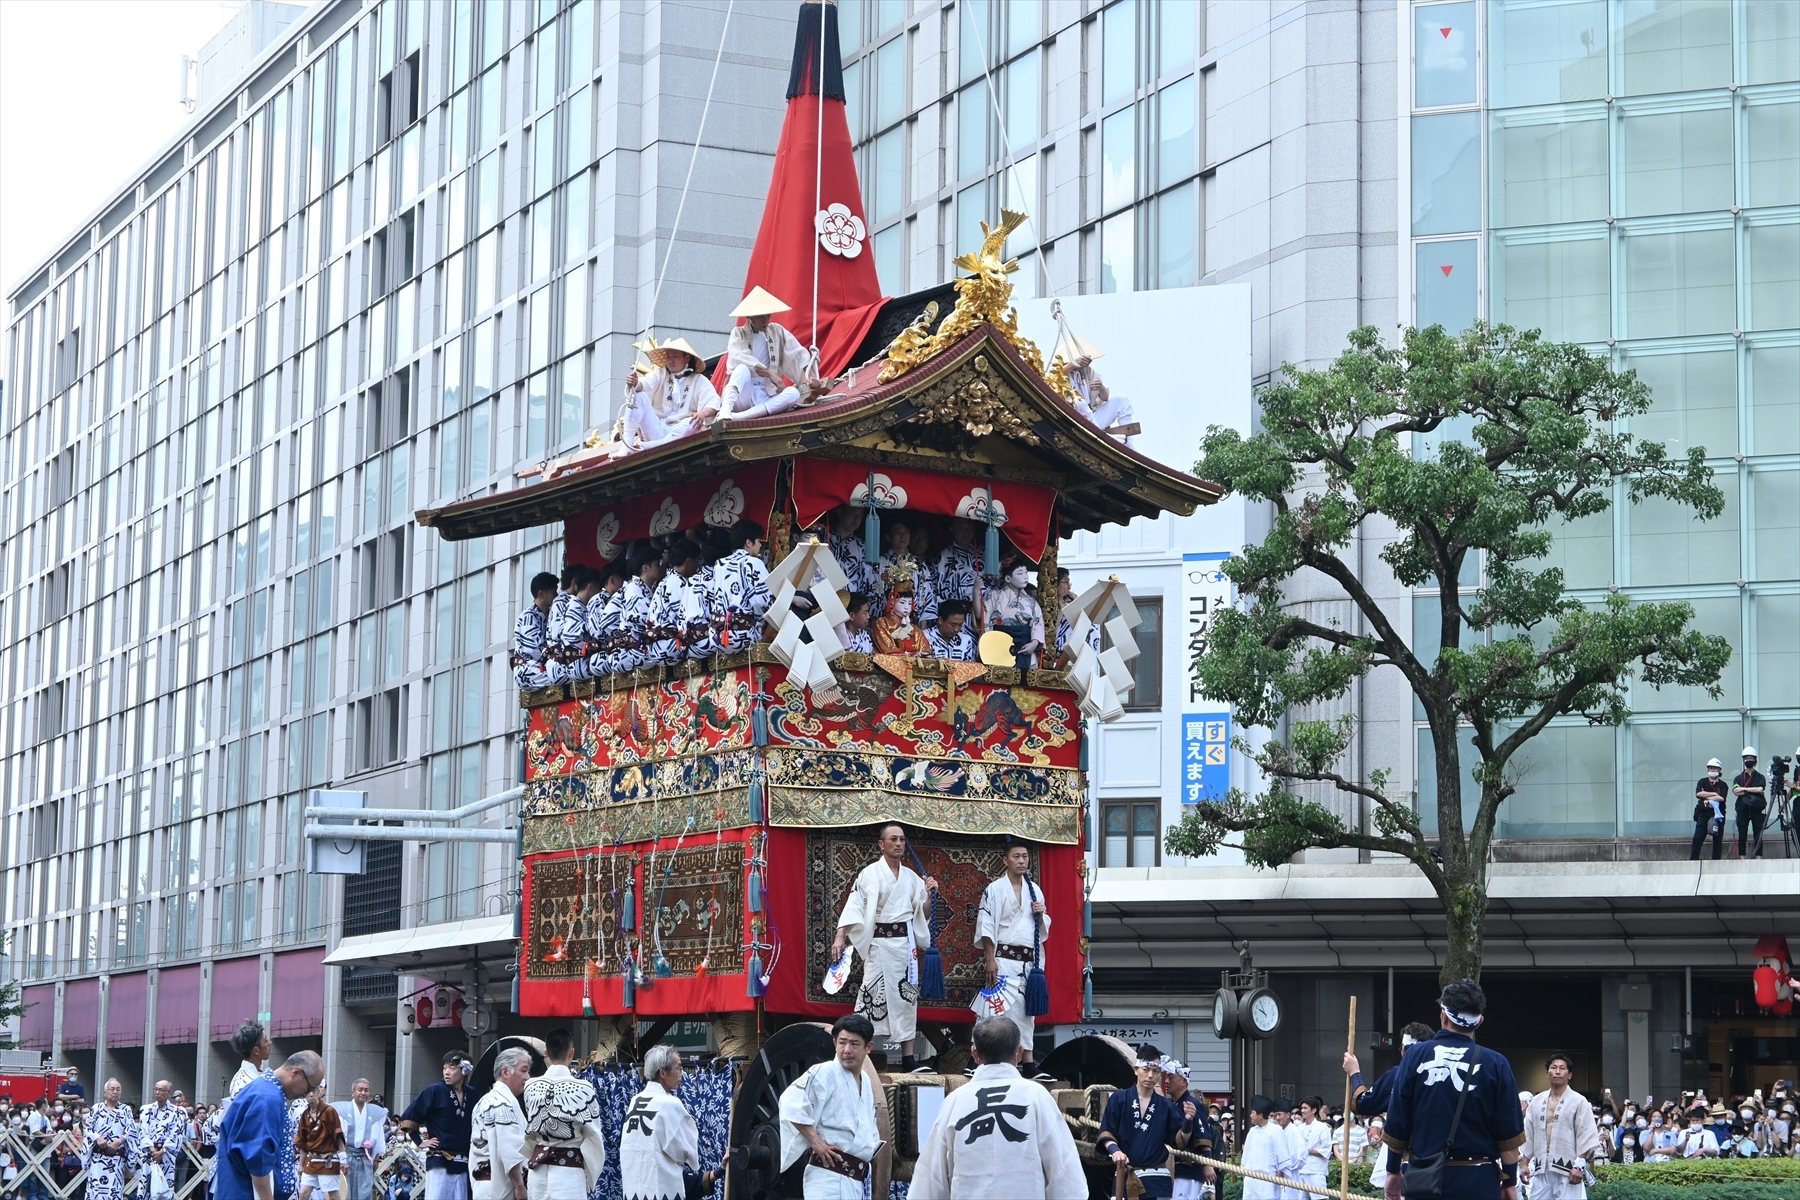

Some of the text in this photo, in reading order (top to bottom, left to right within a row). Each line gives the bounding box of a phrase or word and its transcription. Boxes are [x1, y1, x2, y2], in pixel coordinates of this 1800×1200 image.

[1186, 721, 1204, 801] 買えます
[1207, 723, 1224, 763] すぐ
[1100, 1029, 1159, 1038] メガネスーパー
[624, 1096, 659, 1136] 長
[954, 1084, 1030, 1145] 長
